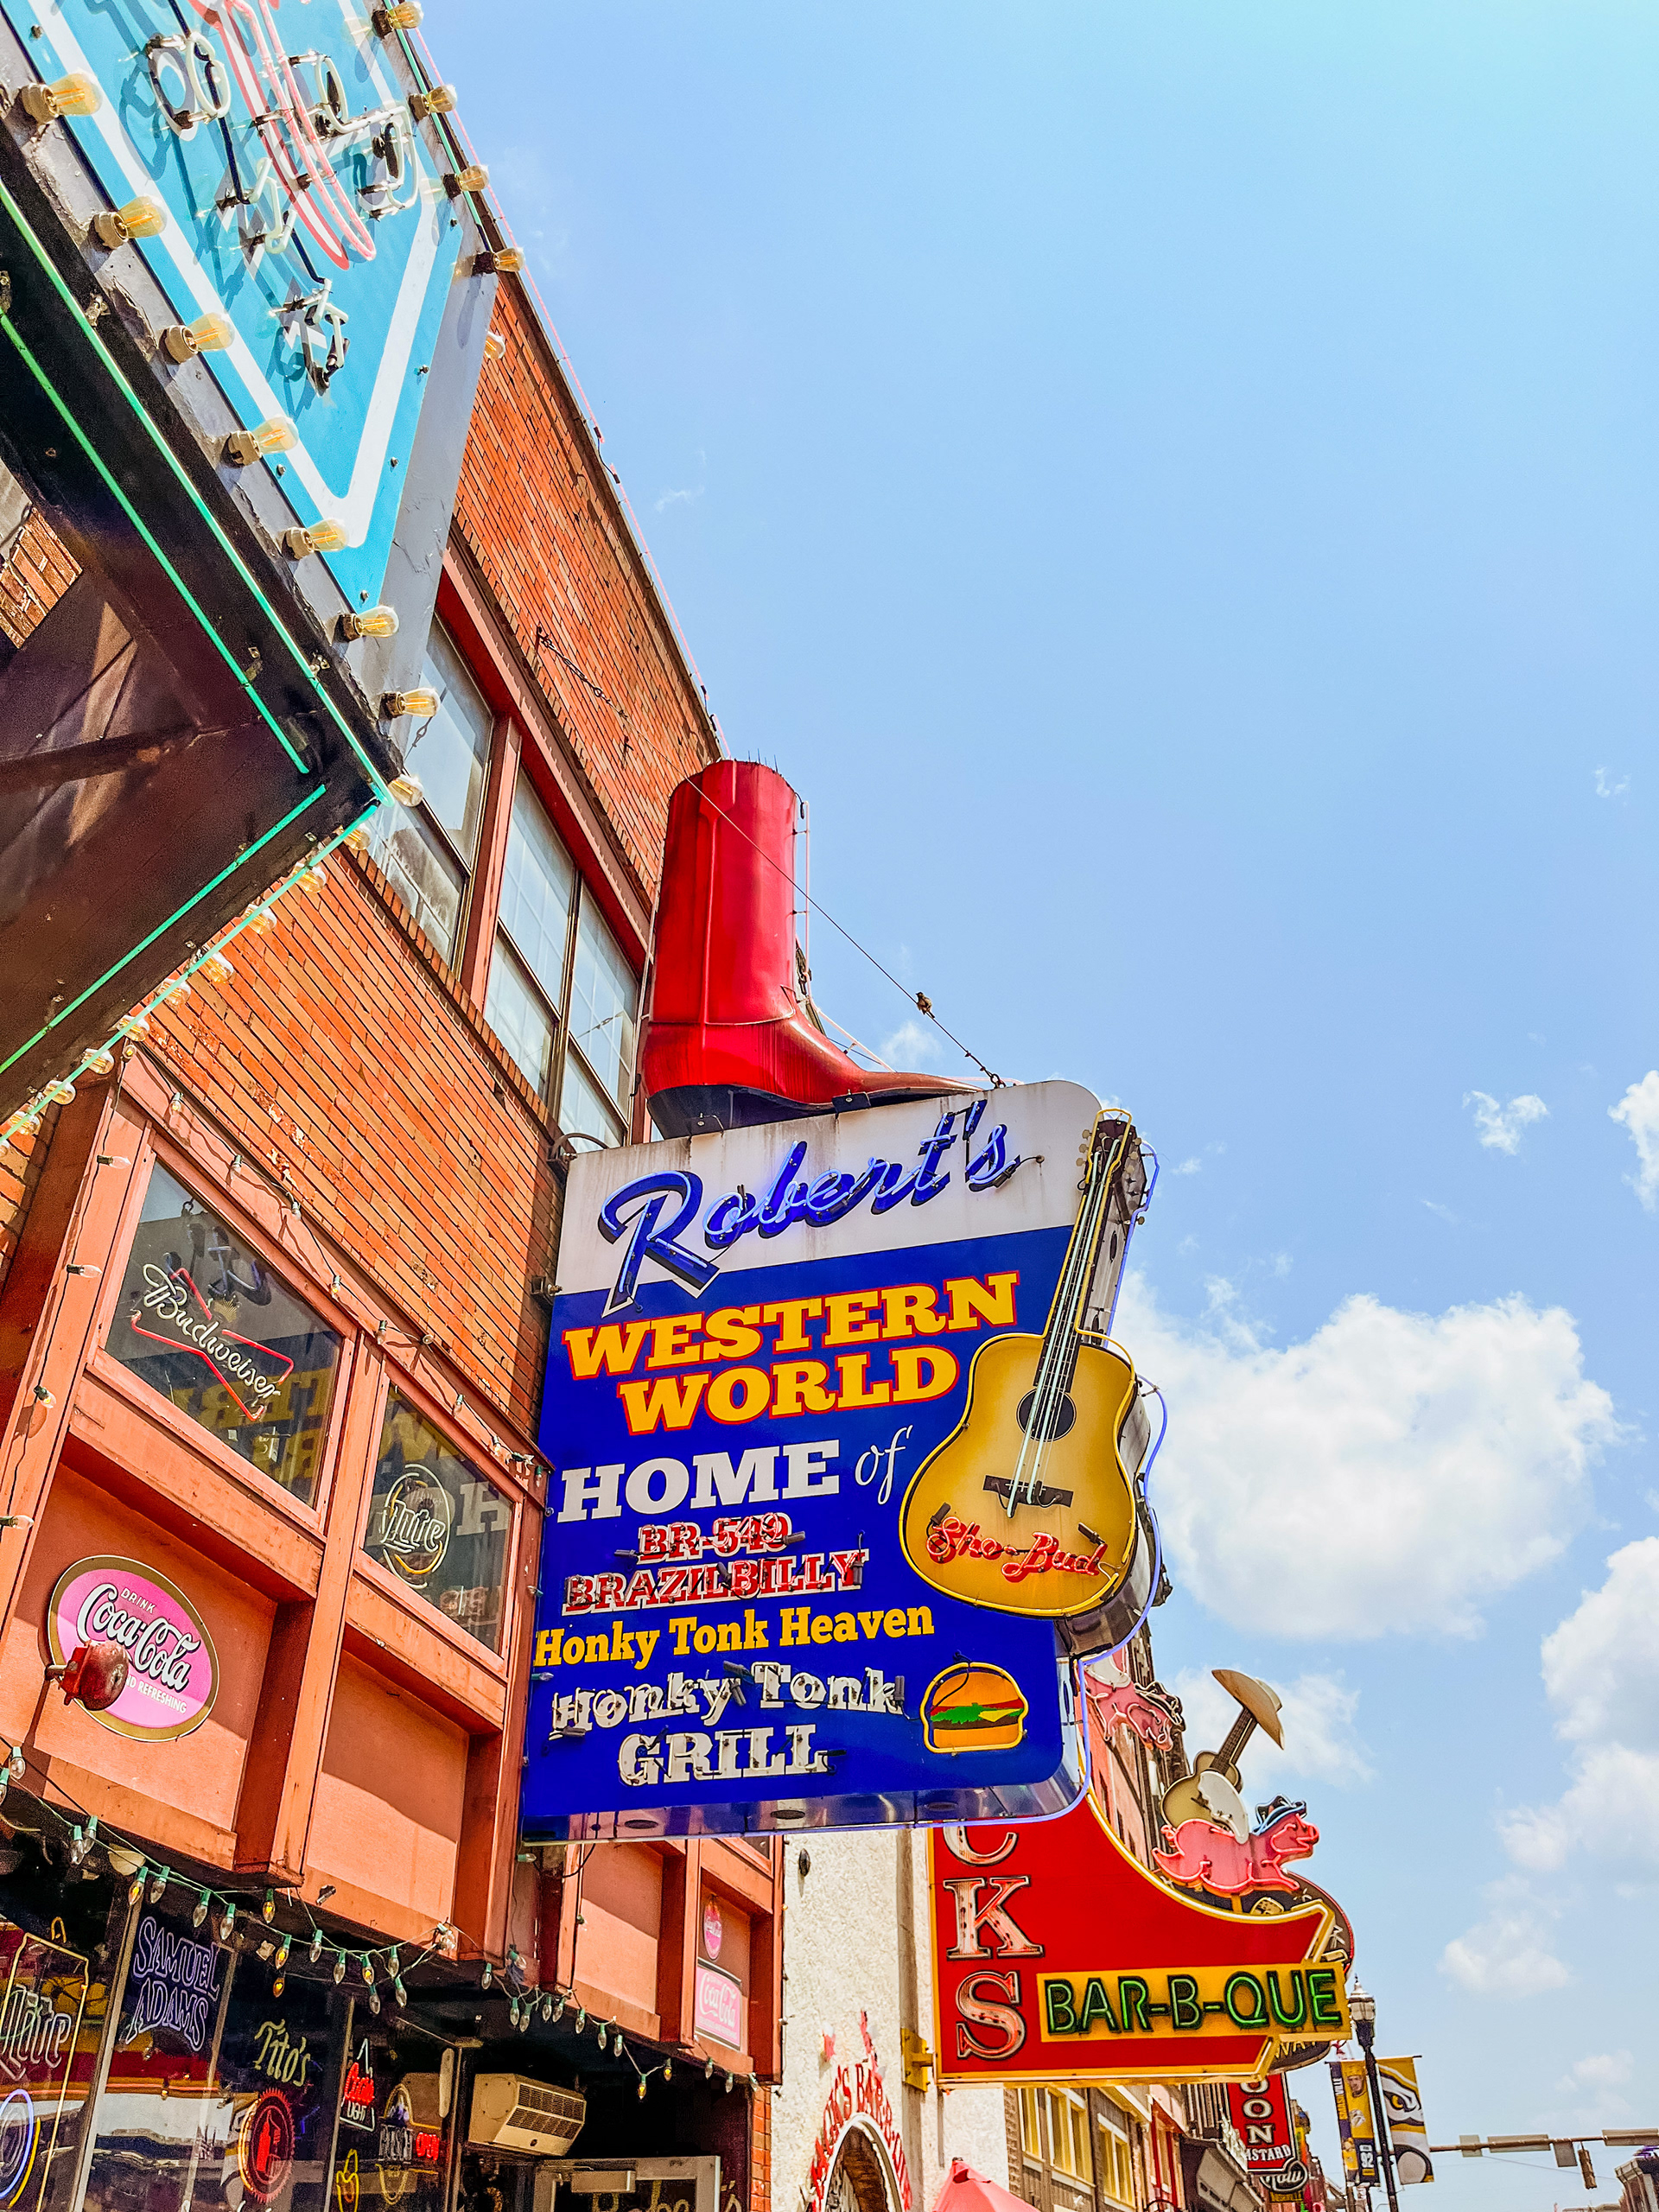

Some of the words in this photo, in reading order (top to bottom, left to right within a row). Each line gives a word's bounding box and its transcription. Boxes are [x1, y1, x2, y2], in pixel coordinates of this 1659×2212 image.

[598, 1099, 1020, 1318] Robert's
[143, 1263, 281, 1399] Budweiser
[563, 1271, 1020, 1381] WESTERN
[617, 1345, 959, 1436] WORLD
[557, 1440, 839, 1522] HOME
[855, 1425, 913, 1504] of
[381, 1499, 445, 1554] Lite
[637, 1512, 792, 1565] BR-549
[121, 1588, 156, 1614] DRINK
[562, 1548, 869, 1616] BRAZILBILLY
[76, 1583, 200, 1693] Coca-Cola
[534, 1621, 660, 1670] Honky
[669, 1609, 769, 1656] Tonk
[779, 1605, 934, 1647] Heaven
[137, 1681, 188, 1714] REFRESHING
[550, 1671, 741, 1739] Honky
[752, 1662, 903, 1715] Tonk
[619, 1724, 828, 1786] GRILL
[133, 1916, 220, 2001] SAMUEL
[126, 1978, 208, 2051] ADAMS
[1045, 1968, 1343, 2035] BAR-B-QUE
[253, 2018, 311, 2087] Tito's
[1360, 2152, 1375, 2169] 92
